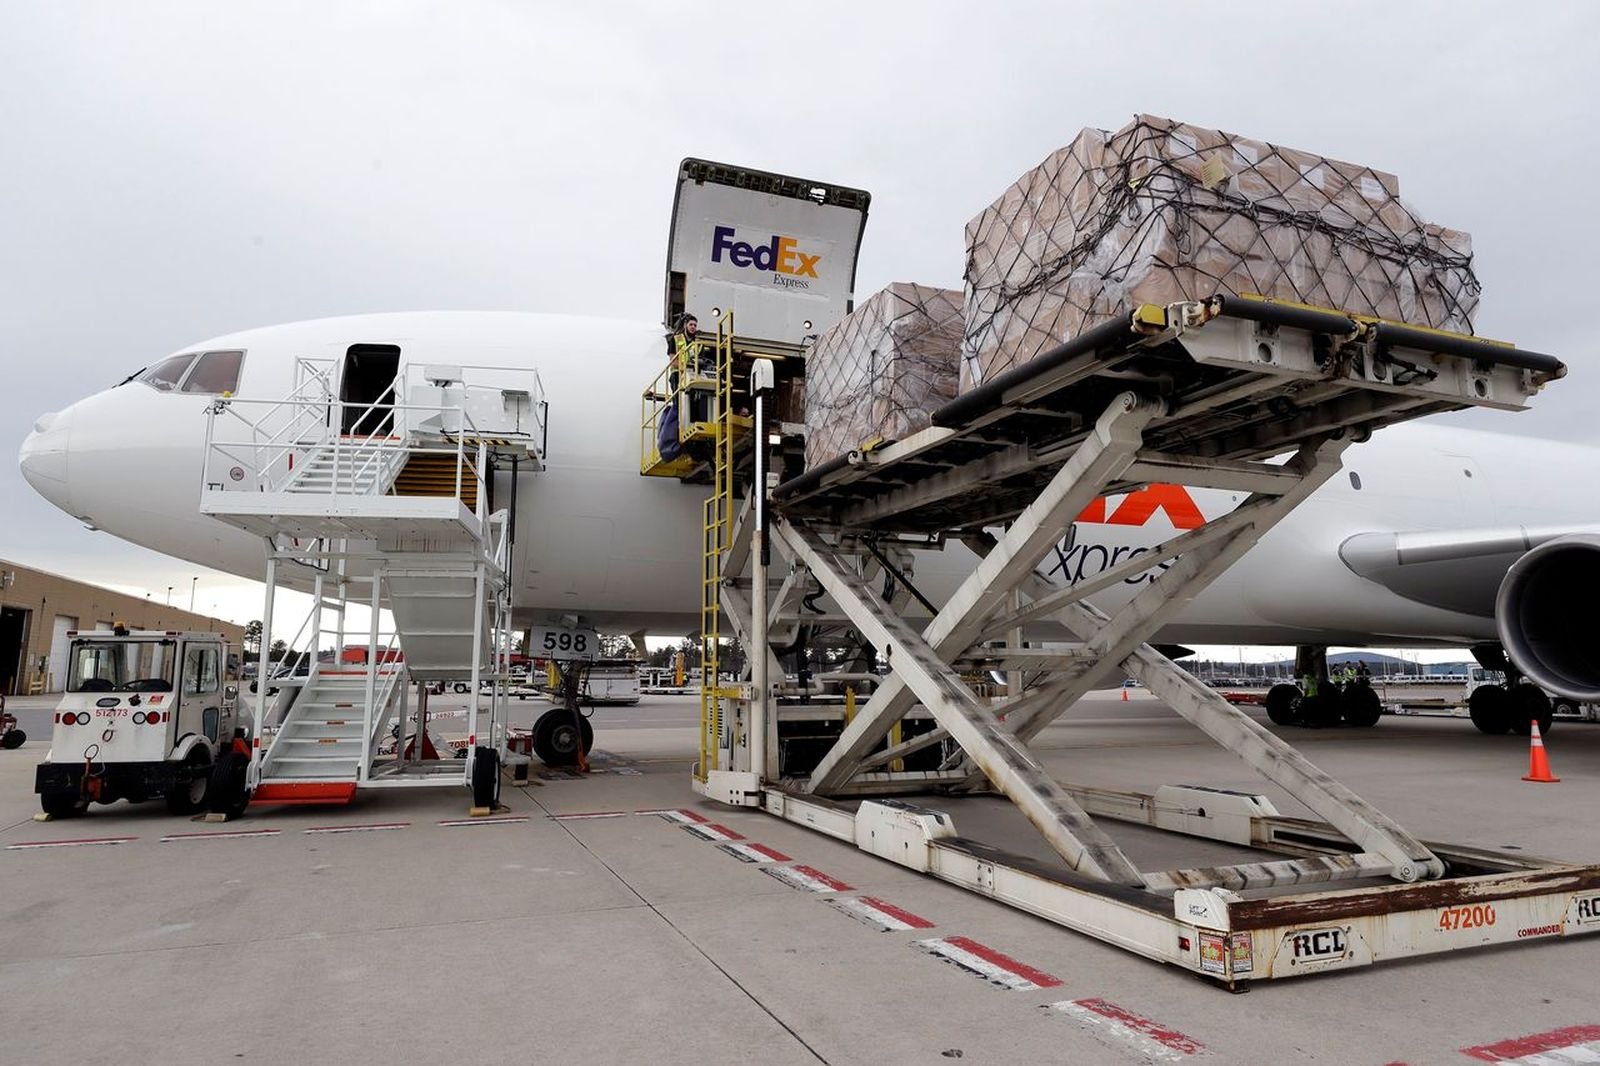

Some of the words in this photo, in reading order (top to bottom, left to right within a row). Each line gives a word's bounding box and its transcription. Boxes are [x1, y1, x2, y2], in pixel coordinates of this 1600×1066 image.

[711, 226, 822, 278] FedEx
[772, 273, 810, 289] Express
[543, 631, 587, 652] 598
[95, 708, 129, 717] 512173
[1438, 903, 1496, 932] 47200
[1517, 924, 1561, 938] COMMANDER
[1292, 930, 1345, 958] RCL
